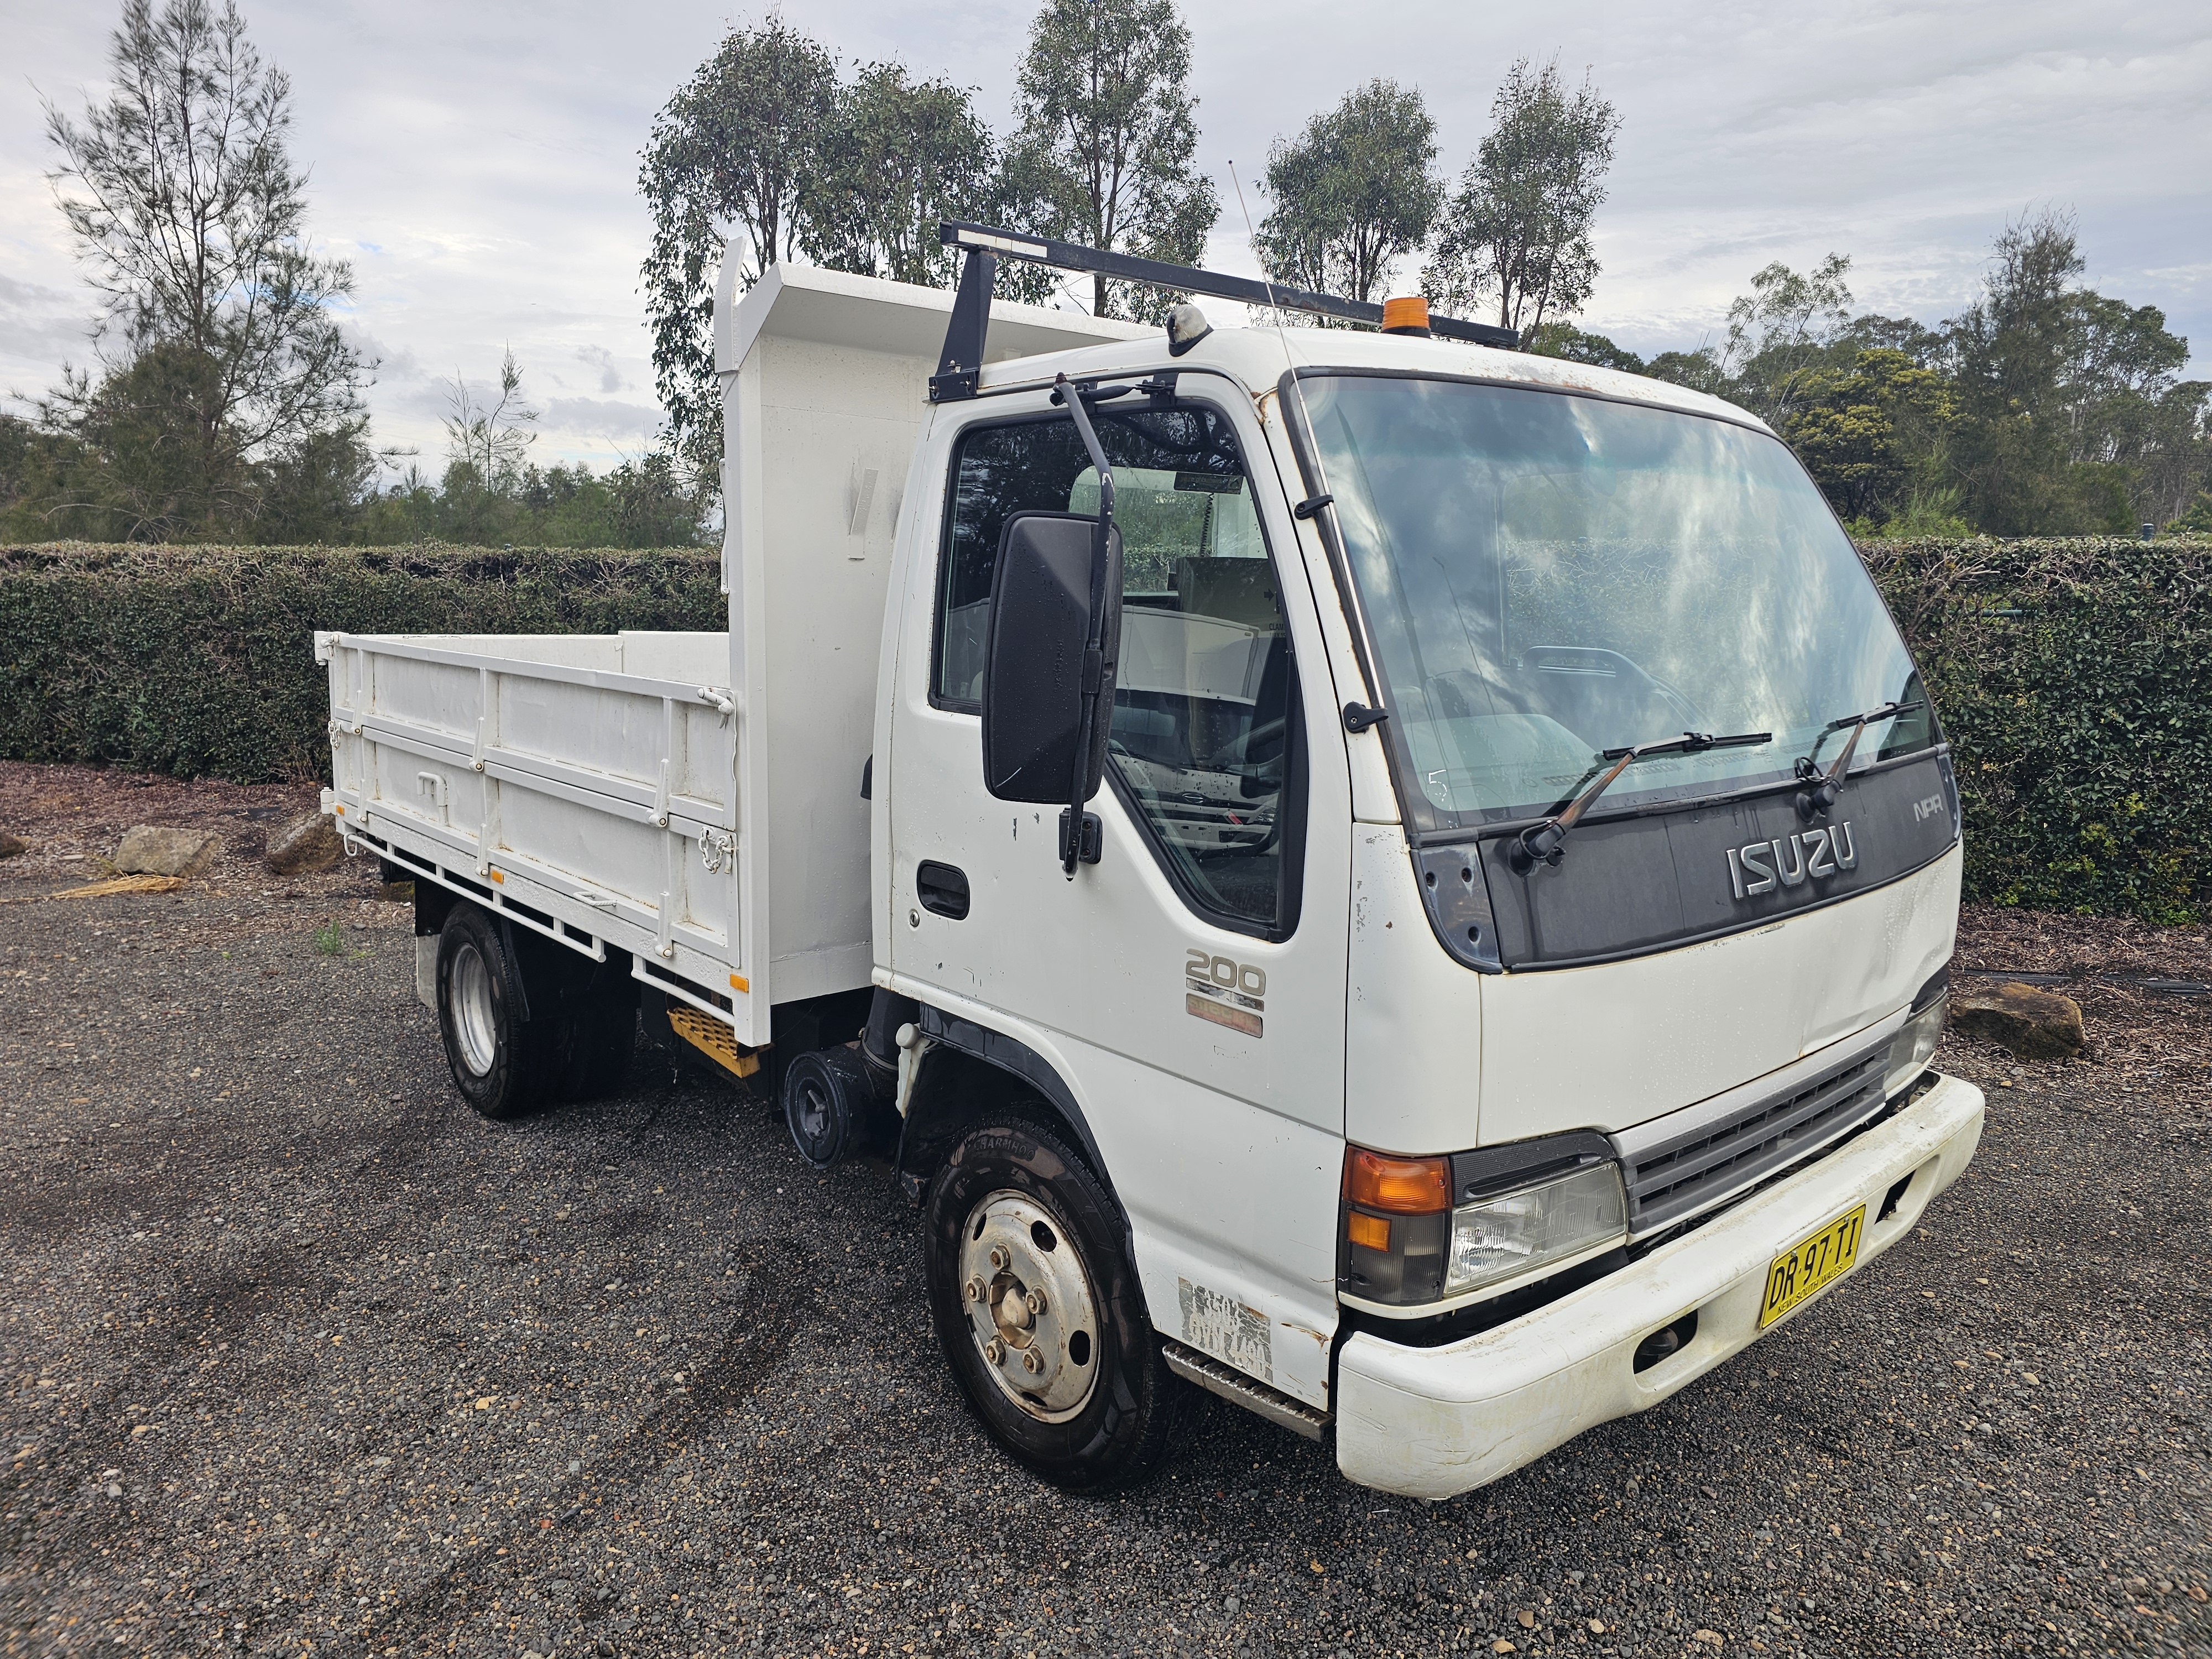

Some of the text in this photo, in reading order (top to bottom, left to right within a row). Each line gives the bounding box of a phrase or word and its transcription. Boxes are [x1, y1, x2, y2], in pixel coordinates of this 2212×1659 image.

[1913, 794, 1944, 822] NPR
[1726, 821, 1858, 901] ISUZU
[1186, 948, 1266, 997] 200
[1777, 1261, 1843, 1314] NEW SOUTH WALES
